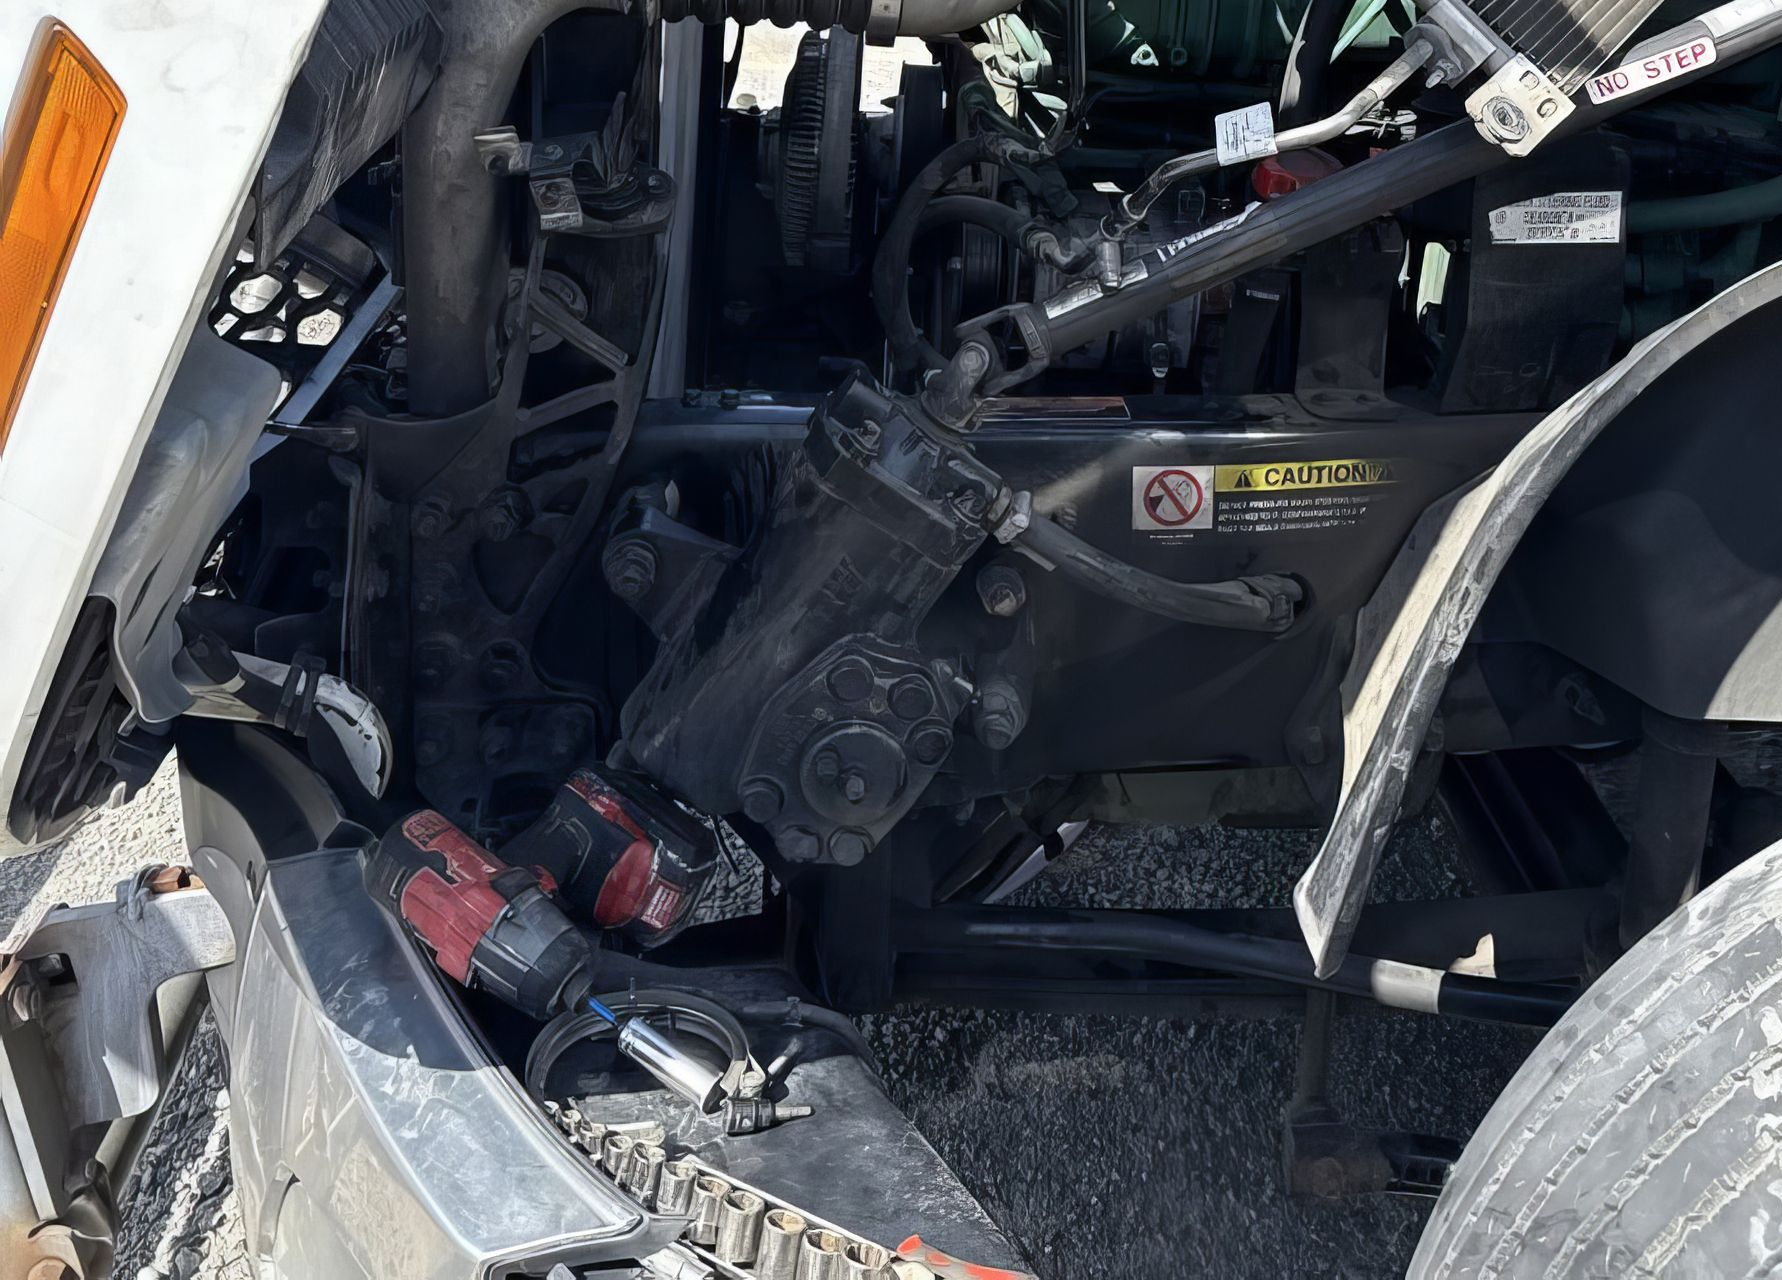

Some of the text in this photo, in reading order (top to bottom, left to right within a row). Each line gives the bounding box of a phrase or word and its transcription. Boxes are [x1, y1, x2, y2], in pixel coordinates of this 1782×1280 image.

[1596, 43, 1706, 97] NO STEP
[1264, 462, 1367, 486] CAUTION
